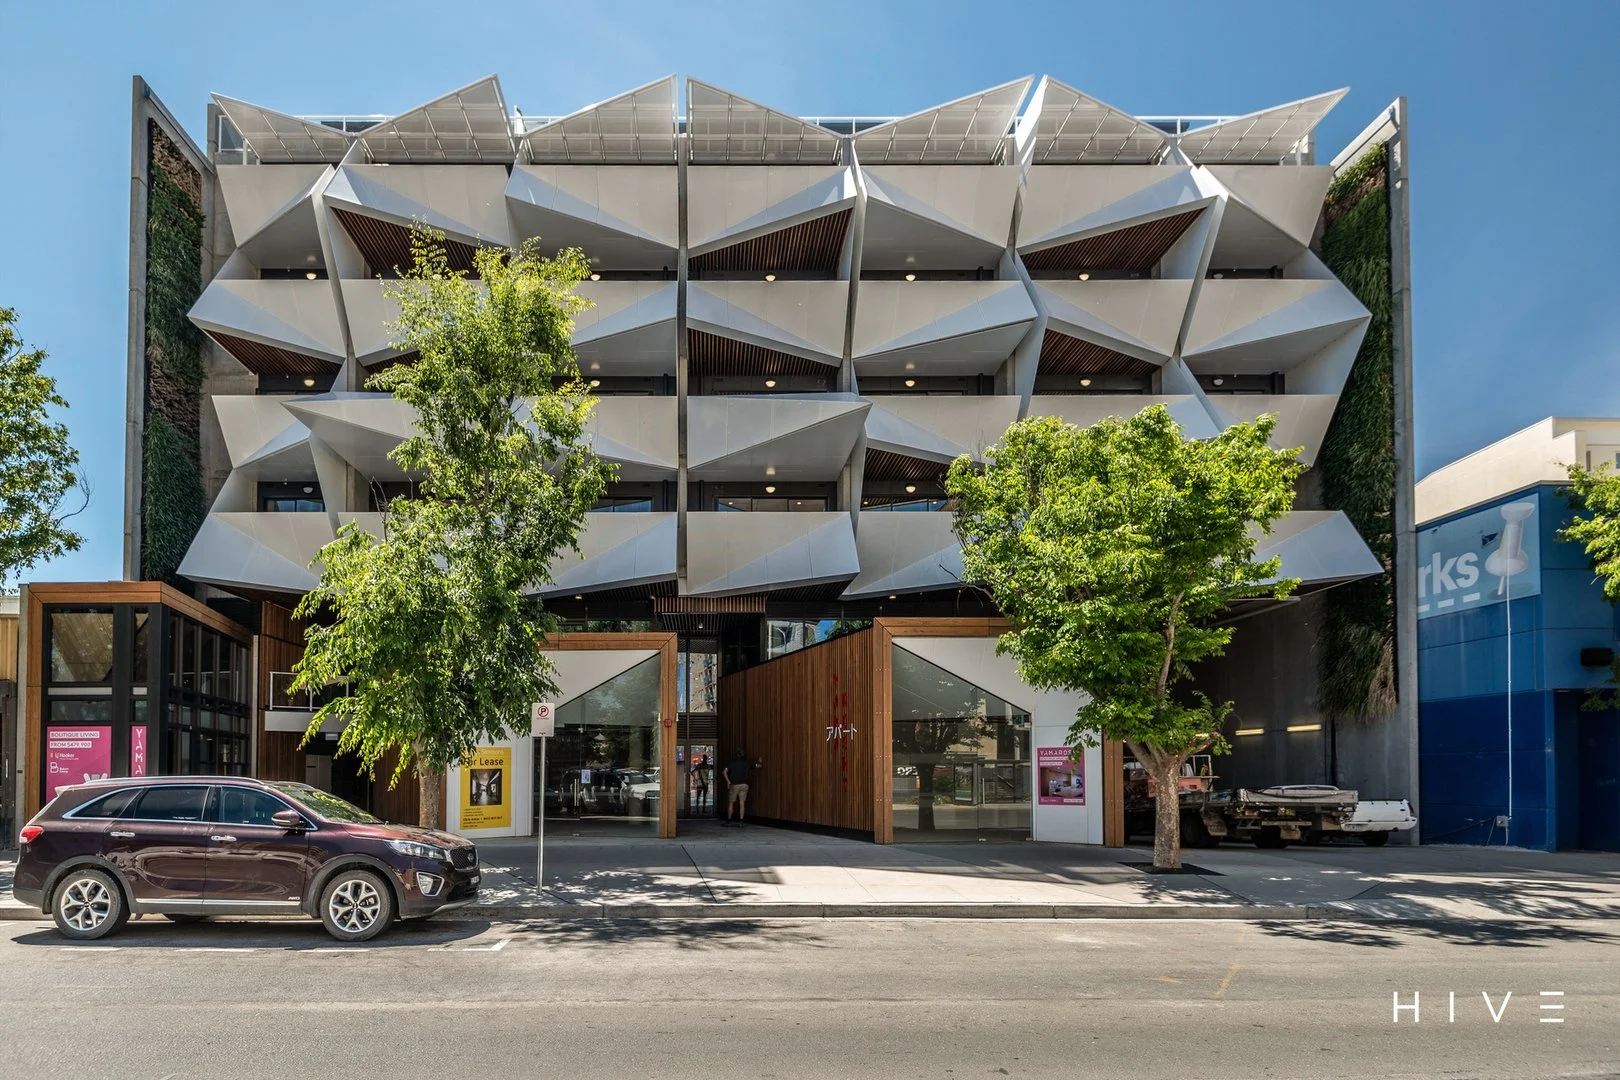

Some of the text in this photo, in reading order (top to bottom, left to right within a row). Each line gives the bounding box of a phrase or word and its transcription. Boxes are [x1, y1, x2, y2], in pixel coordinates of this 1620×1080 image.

[826, 722, 858, 742] アパート
[480, 758, 504, 766] Lease
